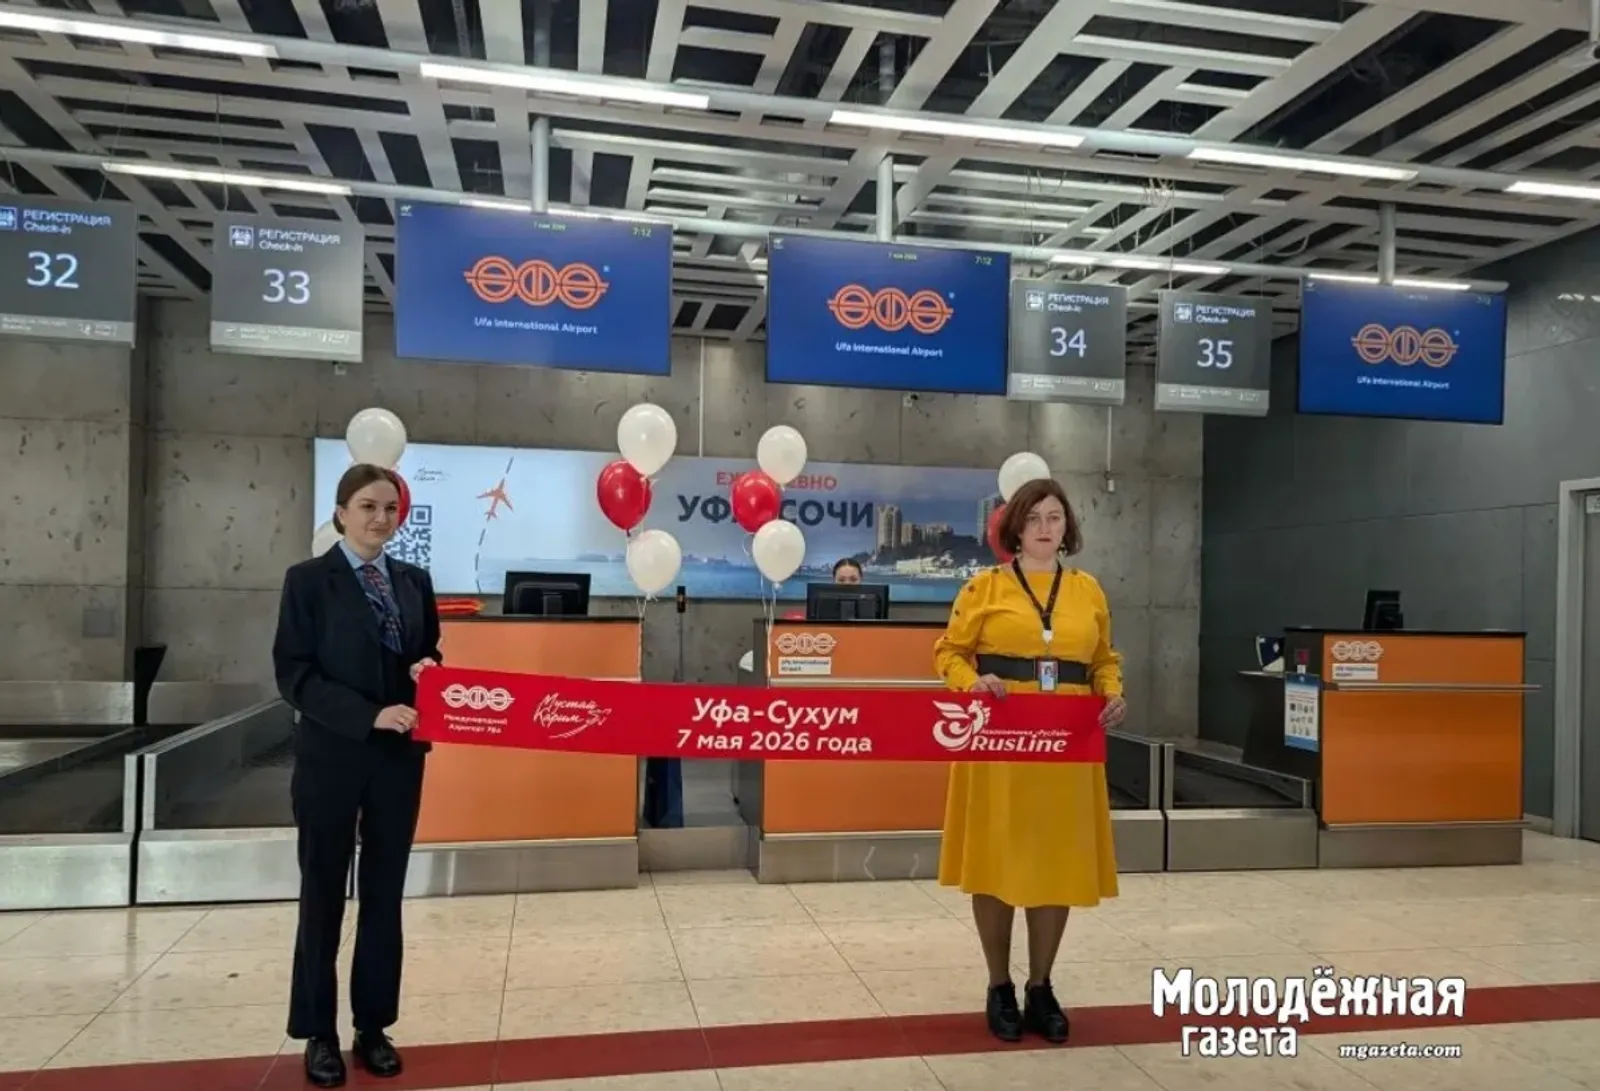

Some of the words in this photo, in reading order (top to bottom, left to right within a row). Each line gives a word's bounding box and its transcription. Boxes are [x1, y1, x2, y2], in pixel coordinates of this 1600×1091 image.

[23, 208, 112, 227] РЕГИСТРАЦИЯ
[23, 221, 72, 234] Check-in
[259, 227, 341, 246] РЕГИСТРАЦИЯ
[259, 240, 303, 252] Check-in
[26, 251, 79, 288] 32
[262, 268, 311, 304] 33
[1047, 292, 1110, 307] РЕГИСТРАЦИЯ
[1195, 303, 1256, 319] РЕГИСТРАЦИЯ
[474, 316, 492, 328] Ufa
[494, 318, 560, 332] International
[561, 322, 599, 336] Airport
[834, 341, 852, 352] Ufa
[853, 342, 910, 356] International
[911, 345, 944, 359] Airport
[1050, 327, 1087, 358] 34
[1197, 339, 1233, 369] 35
[1356, 375, 1371, 384] Ufa
[1373, 376, 1421, 387] International
[1422, 379, 1450, 390] Airport
[691, 697, 859, 731] Уфа-Сухум
[676, 729, 692, 749] 7
[697, 733, 743, 750] мая
[749, 731, 810, 751] 2026
[816, 736, 873, 754] года
[970, 734, 1068, 752] RusLine
